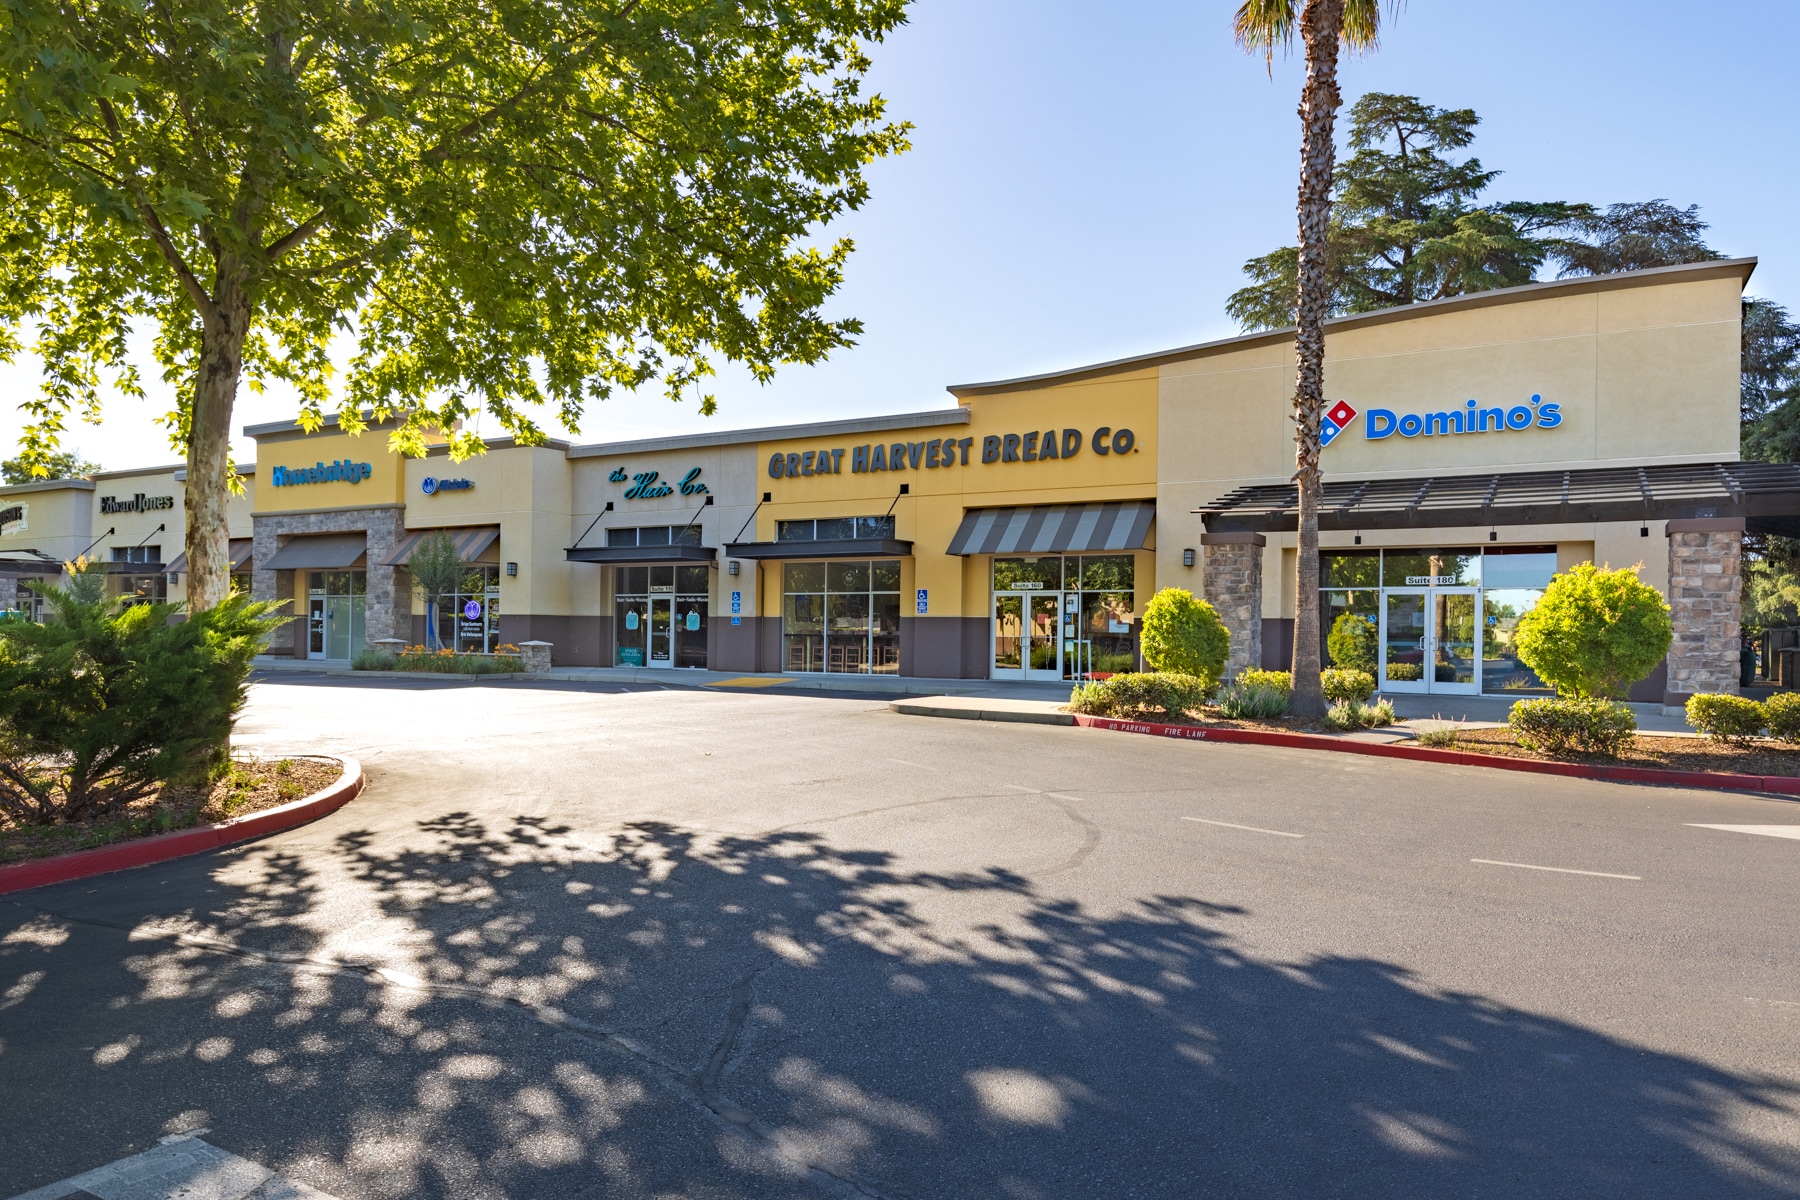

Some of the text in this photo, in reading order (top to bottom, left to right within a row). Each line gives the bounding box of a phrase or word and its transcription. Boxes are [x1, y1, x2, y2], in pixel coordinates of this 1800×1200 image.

[1365, 393, 1563, 440] Domino's
[768, 448, 845, 479] GREAT
[851, 436, 974, 474] HARVEST
[981, 428, 1083, 464] BREAD
[272, 459, 372, 487] Homebridge
[608, 466, 628, 482] the
[624, 471, 674, 499] Hair
[99, 493, 174, 514] Edward Jones
[1408, 576, 1454, 584] Suite 180
[1121, 724, 1150, 733] PARKING
[1164, 727, 1182, 736] FIRE
